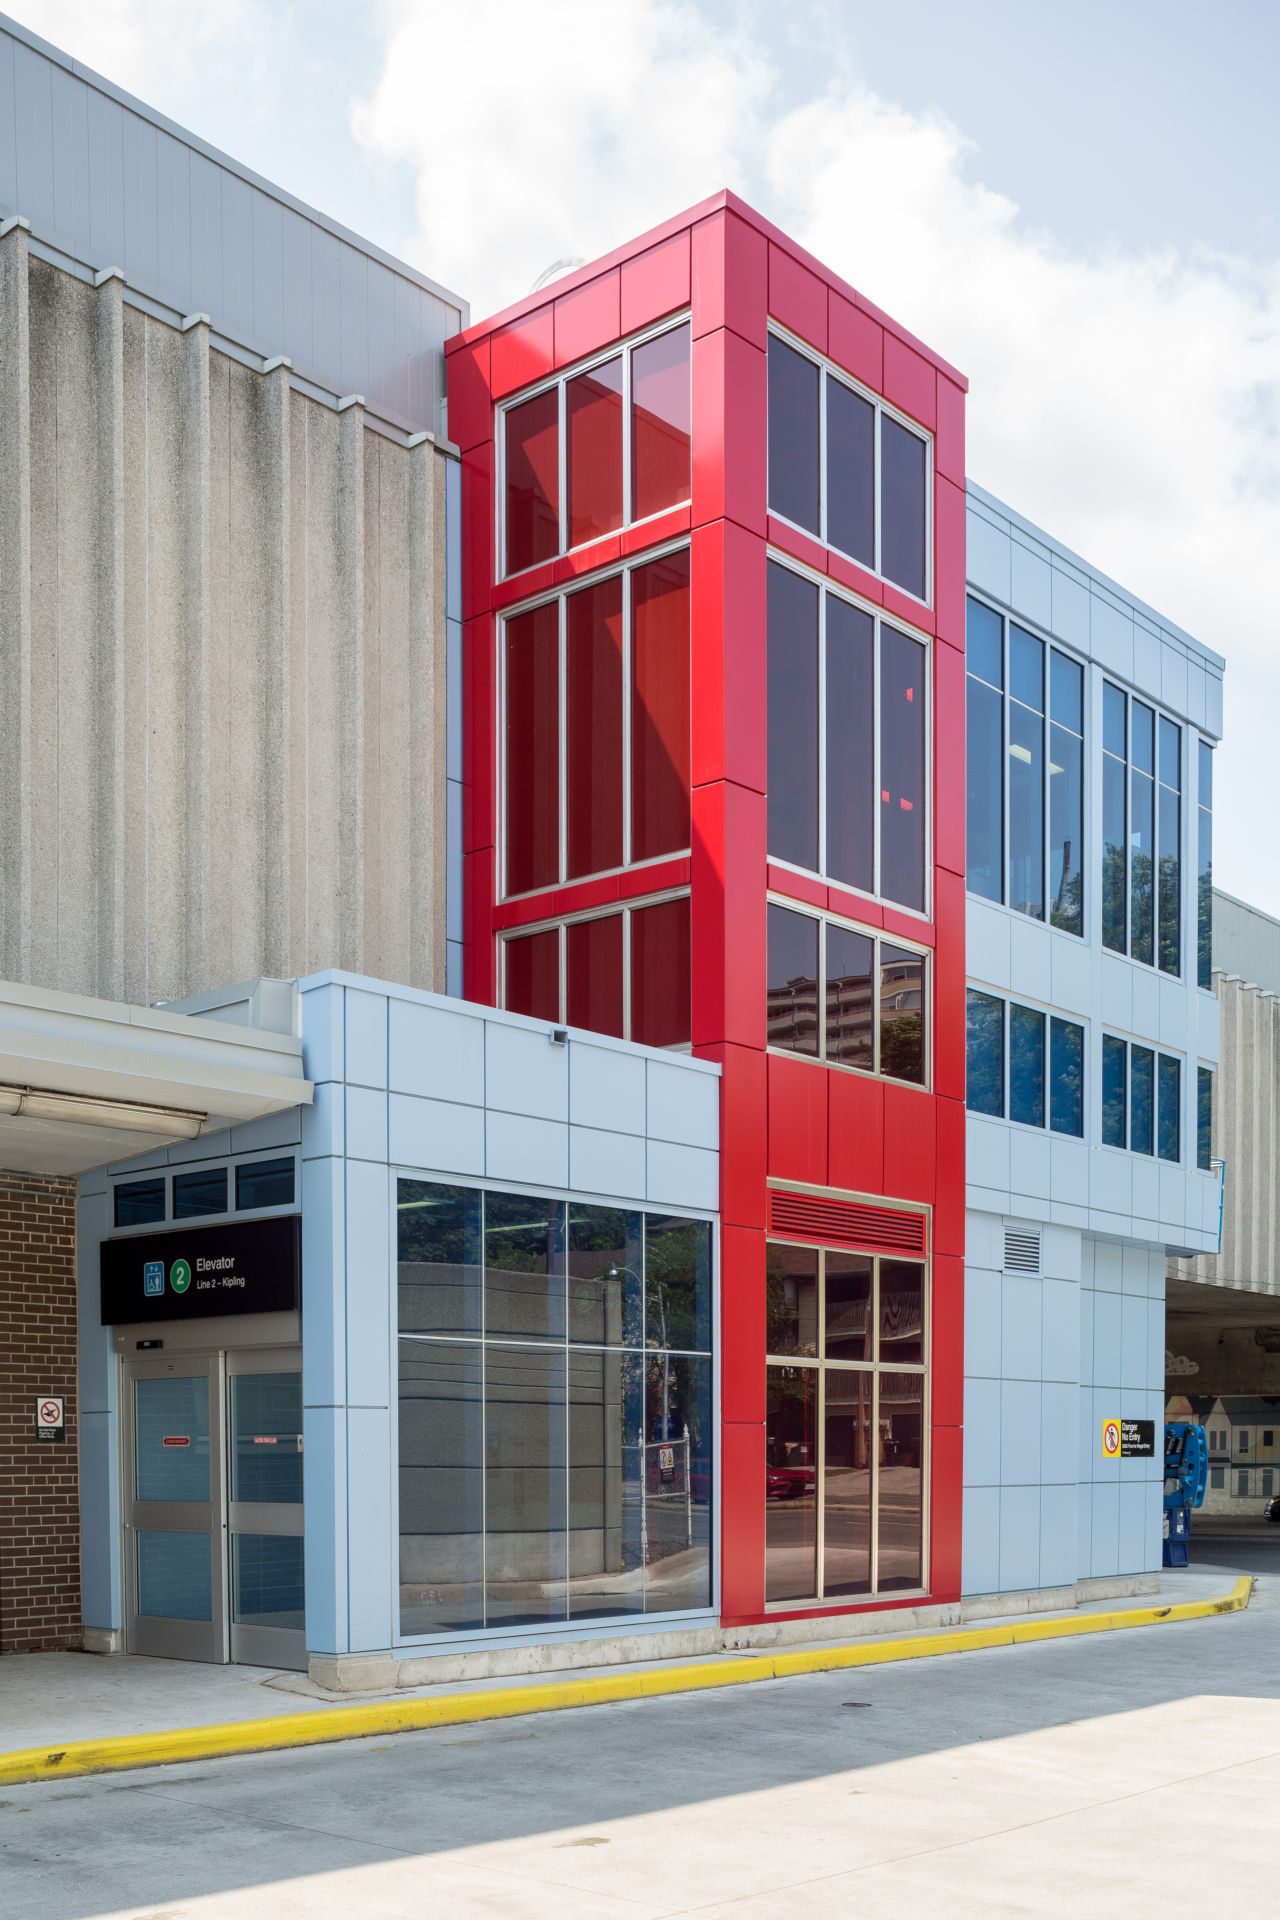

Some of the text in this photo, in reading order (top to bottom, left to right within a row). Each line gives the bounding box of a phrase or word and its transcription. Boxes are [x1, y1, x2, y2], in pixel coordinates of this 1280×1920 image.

[196, 1256, 235, 1272] Elevator
[176, 1268, 184, 1285] 2
[196, 1280, 211, 1289] Line
[211, 1278, 216, 1288] 2
[222, 1277, 245, 1288] Kipling
[1122, 1423, 1137, 1432] Danger
[1129, 1432, 1140, 1442] Entry
